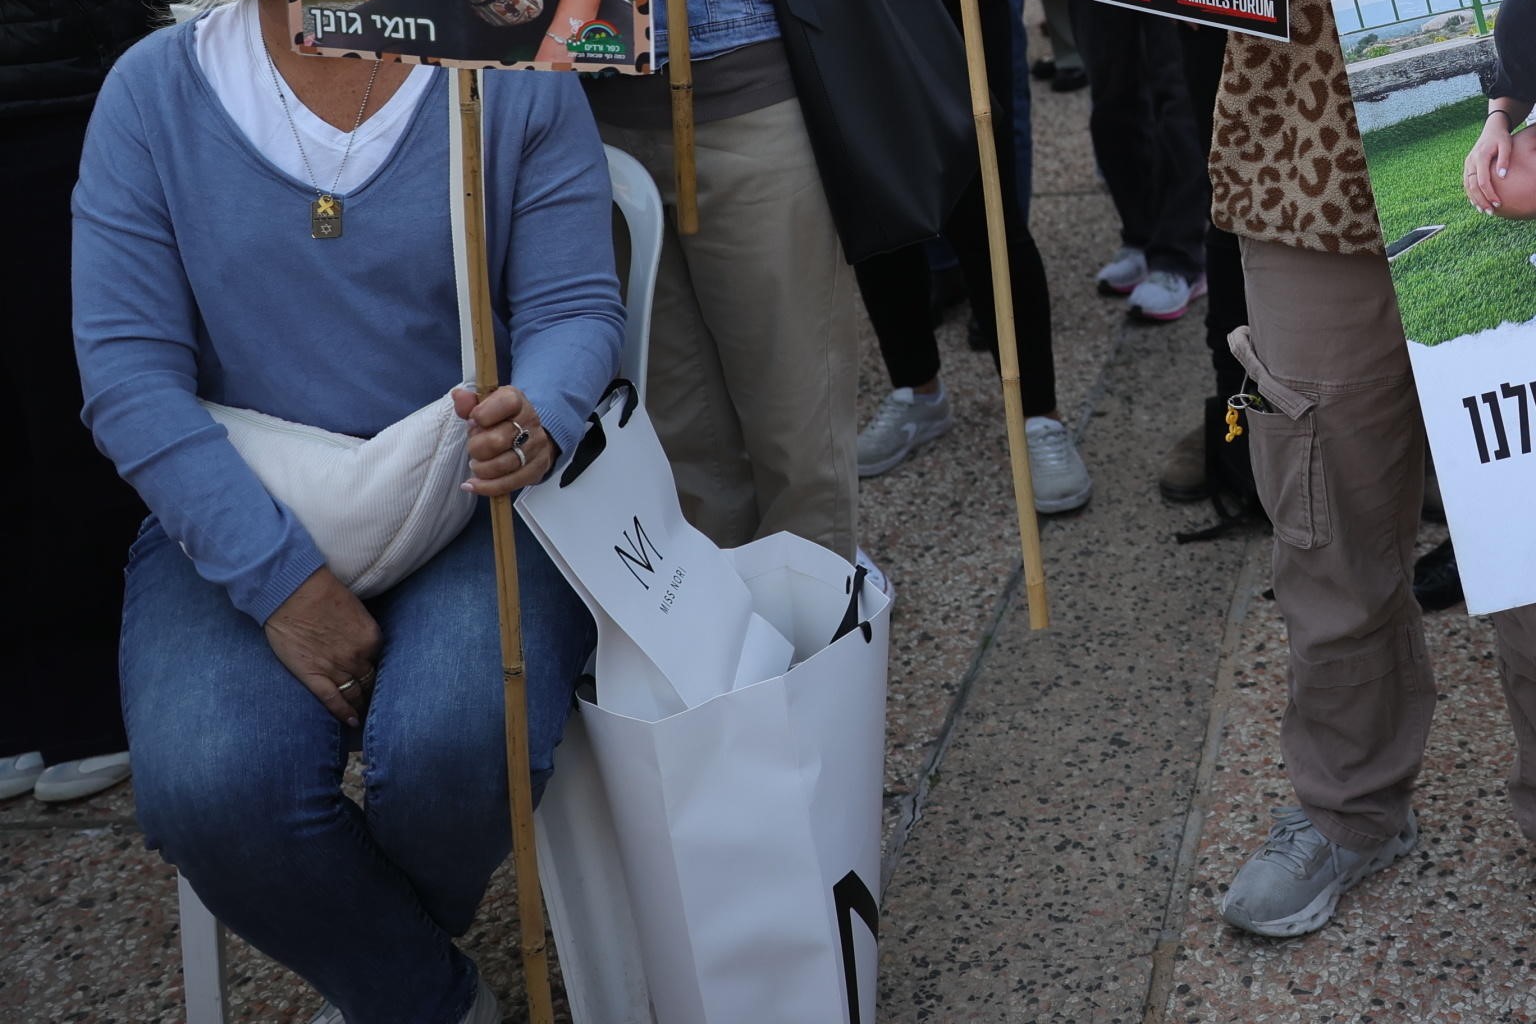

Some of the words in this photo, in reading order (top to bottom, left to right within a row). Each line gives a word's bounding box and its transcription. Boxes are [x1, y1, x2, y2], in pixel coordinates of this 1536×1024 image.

[310, 9, 362, 39] גונן
[371, 14, 436, 41] רומי
[659, 589, 676, 615] MISS
[670, 566, 687, 590] NORI
